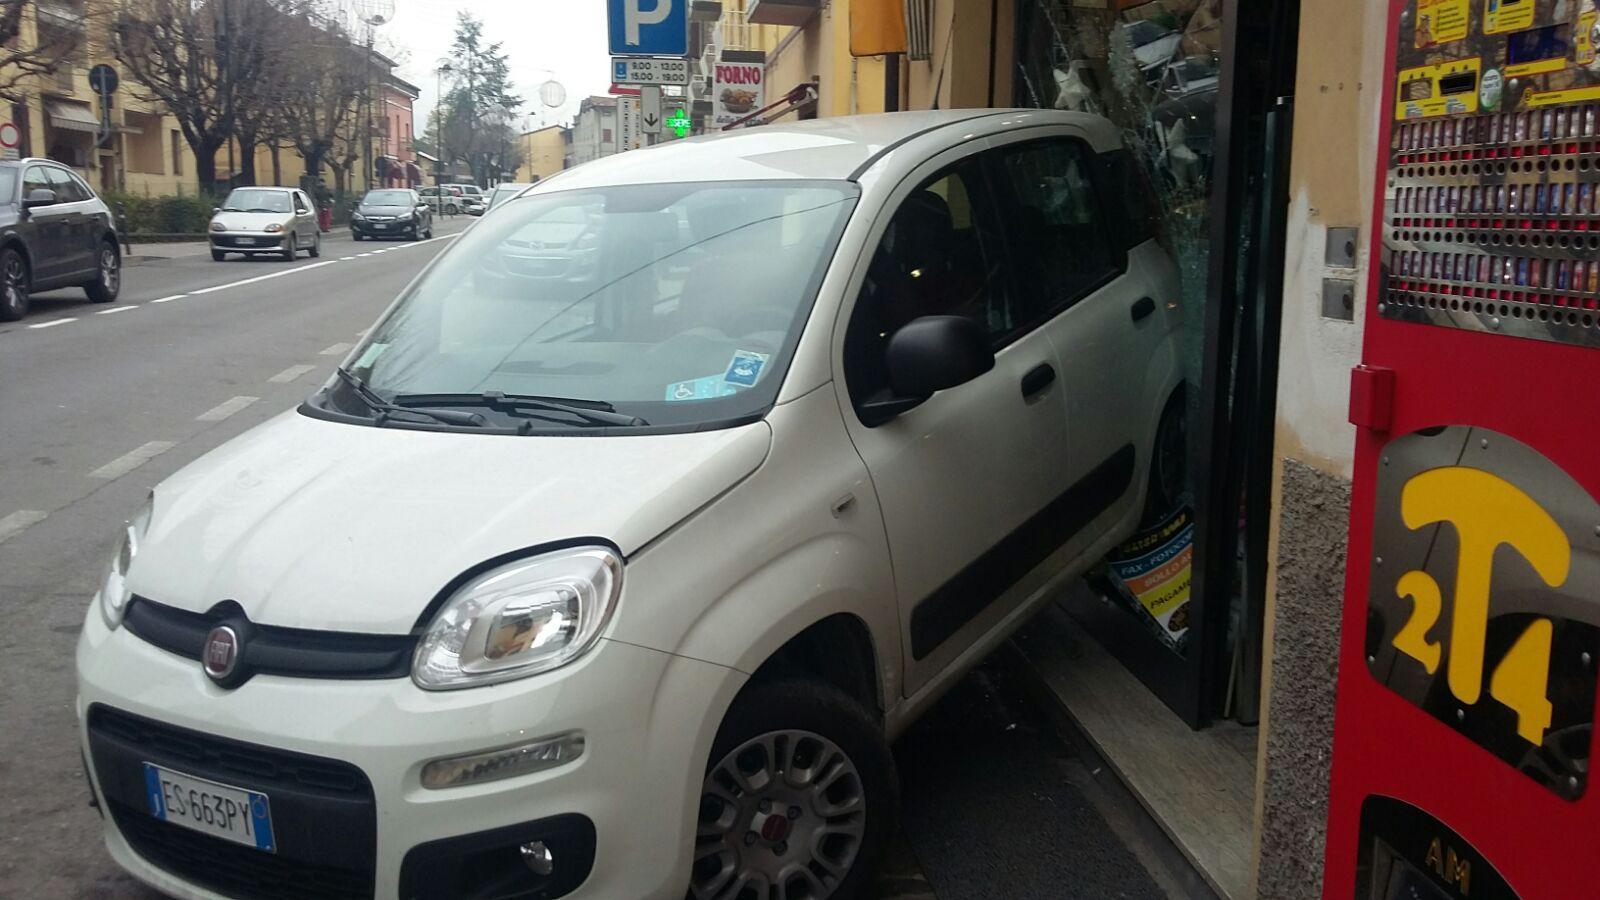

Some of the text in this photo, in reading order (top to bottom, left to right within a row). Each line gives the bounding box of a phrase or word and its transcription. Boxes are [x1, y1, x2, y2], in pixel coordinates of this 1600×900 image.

[624, 0, 672, 46] P
[715, 65, 761, 85] FORNO
[1121, 563, 1143, 576] FAX
